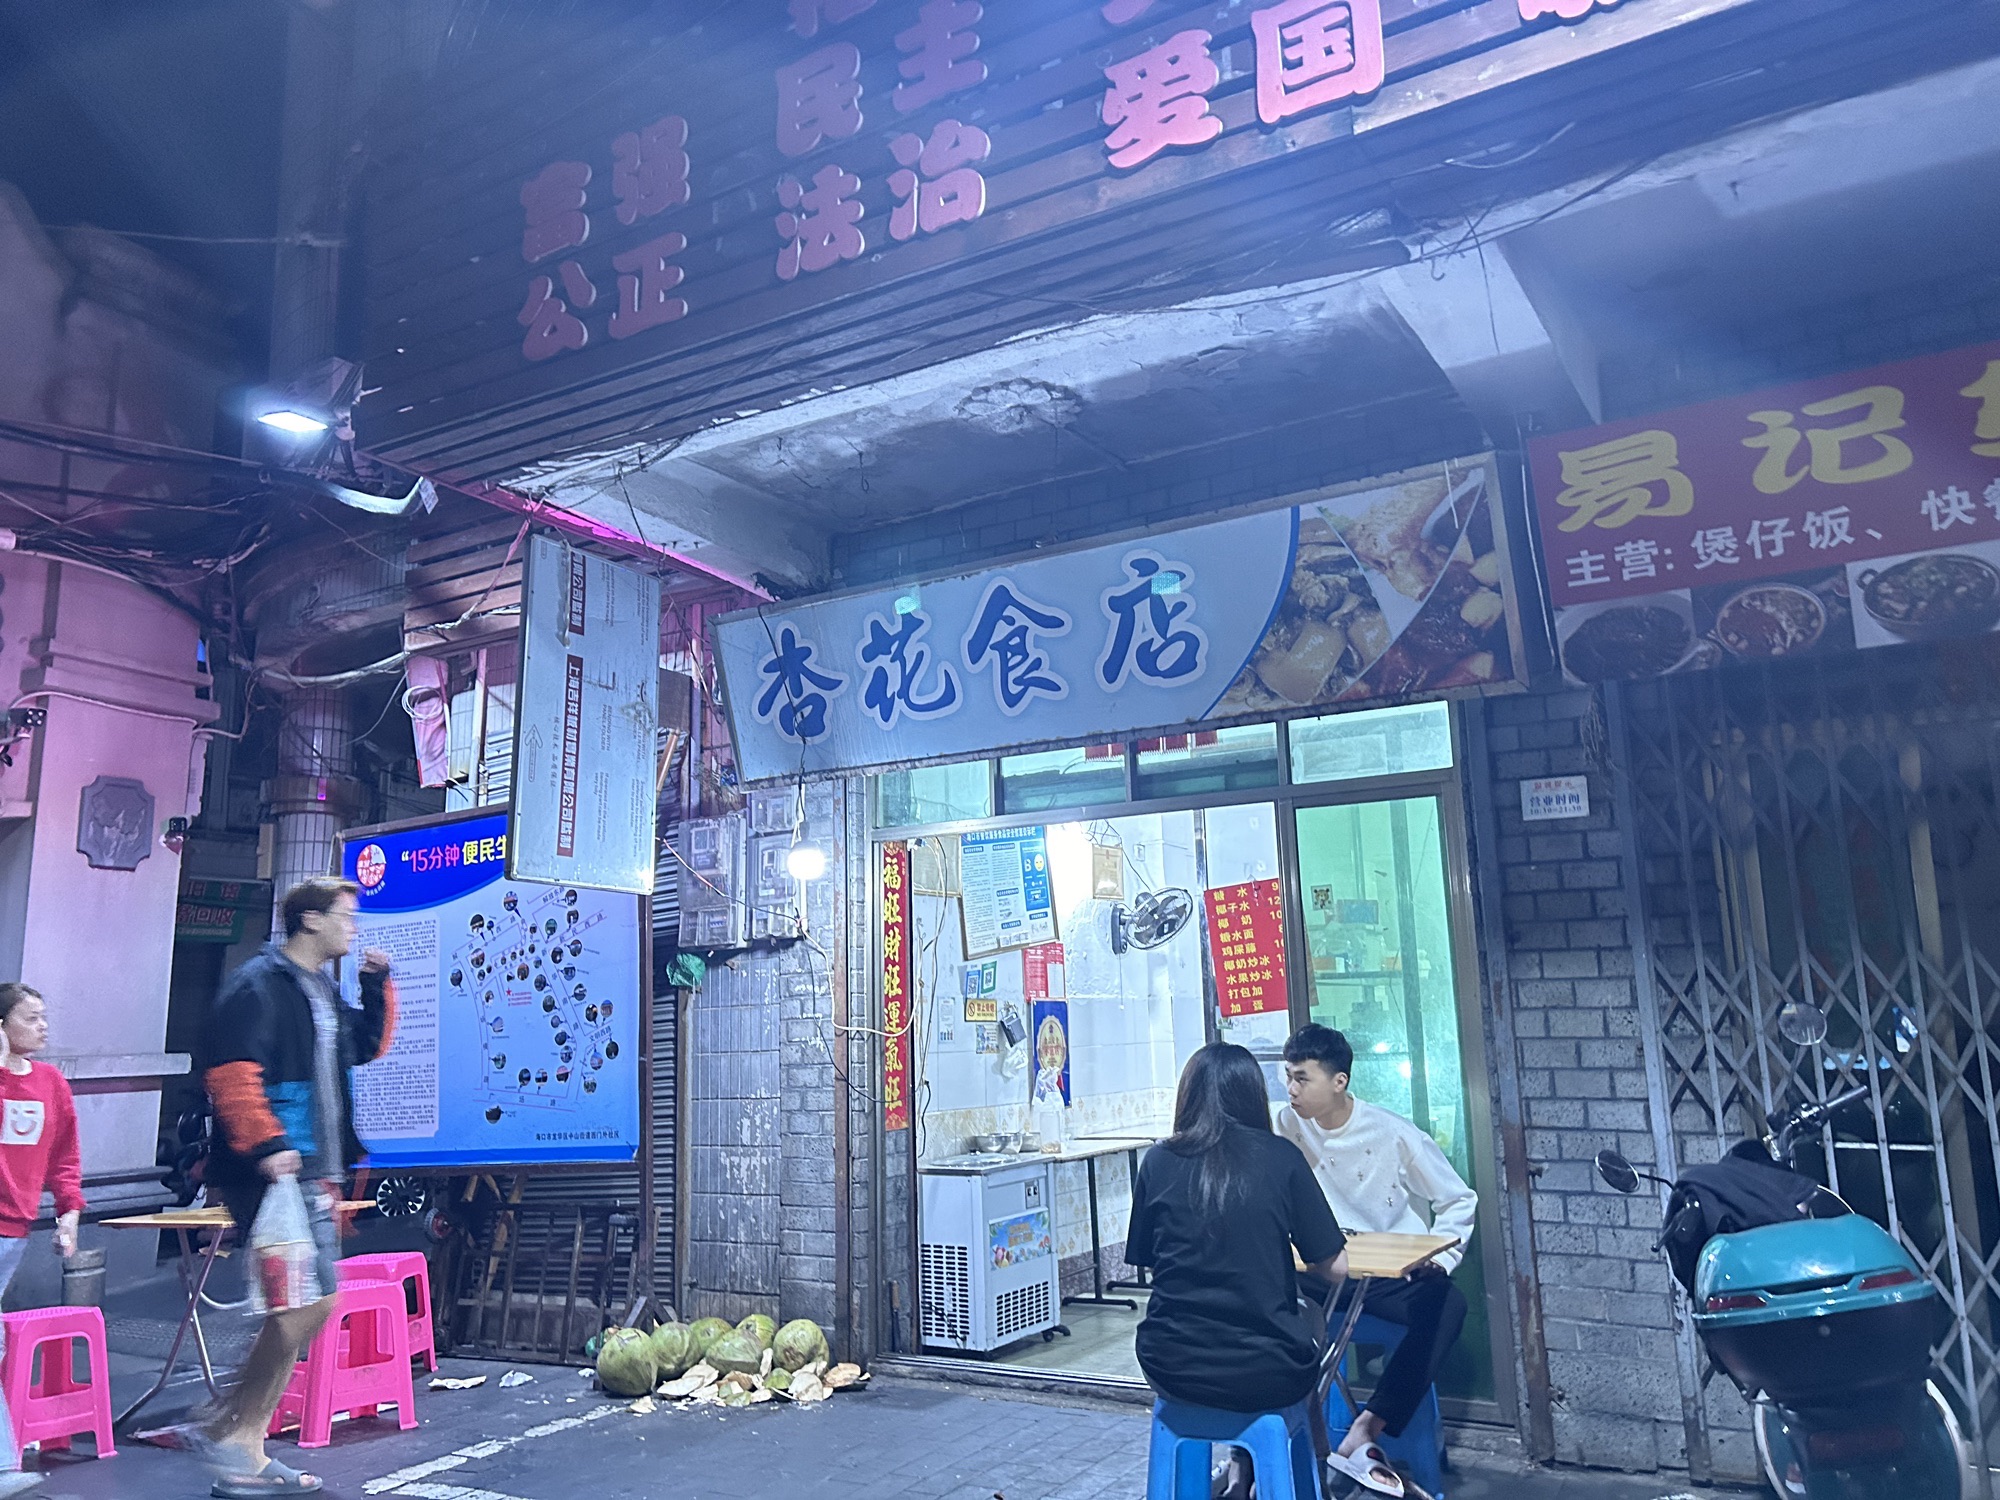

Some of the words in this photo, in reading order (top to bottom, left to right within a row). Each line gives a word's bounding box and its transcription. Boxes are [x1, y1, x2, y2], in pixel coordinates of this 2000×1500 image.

[1102, 0, 1386, 169] 爱国
[775, 119, 992, 281] 法治
[517, 232, 688, 361] 公正
[757, 556, 1202, 739] 杏花食店
[1267, 896, 1281, 905] 12
[1271, 881, 1279, 891] 9
[1226, 969, 1273, 985] 水果炒冰
[1227, 985, 1263, 999] 打包加
